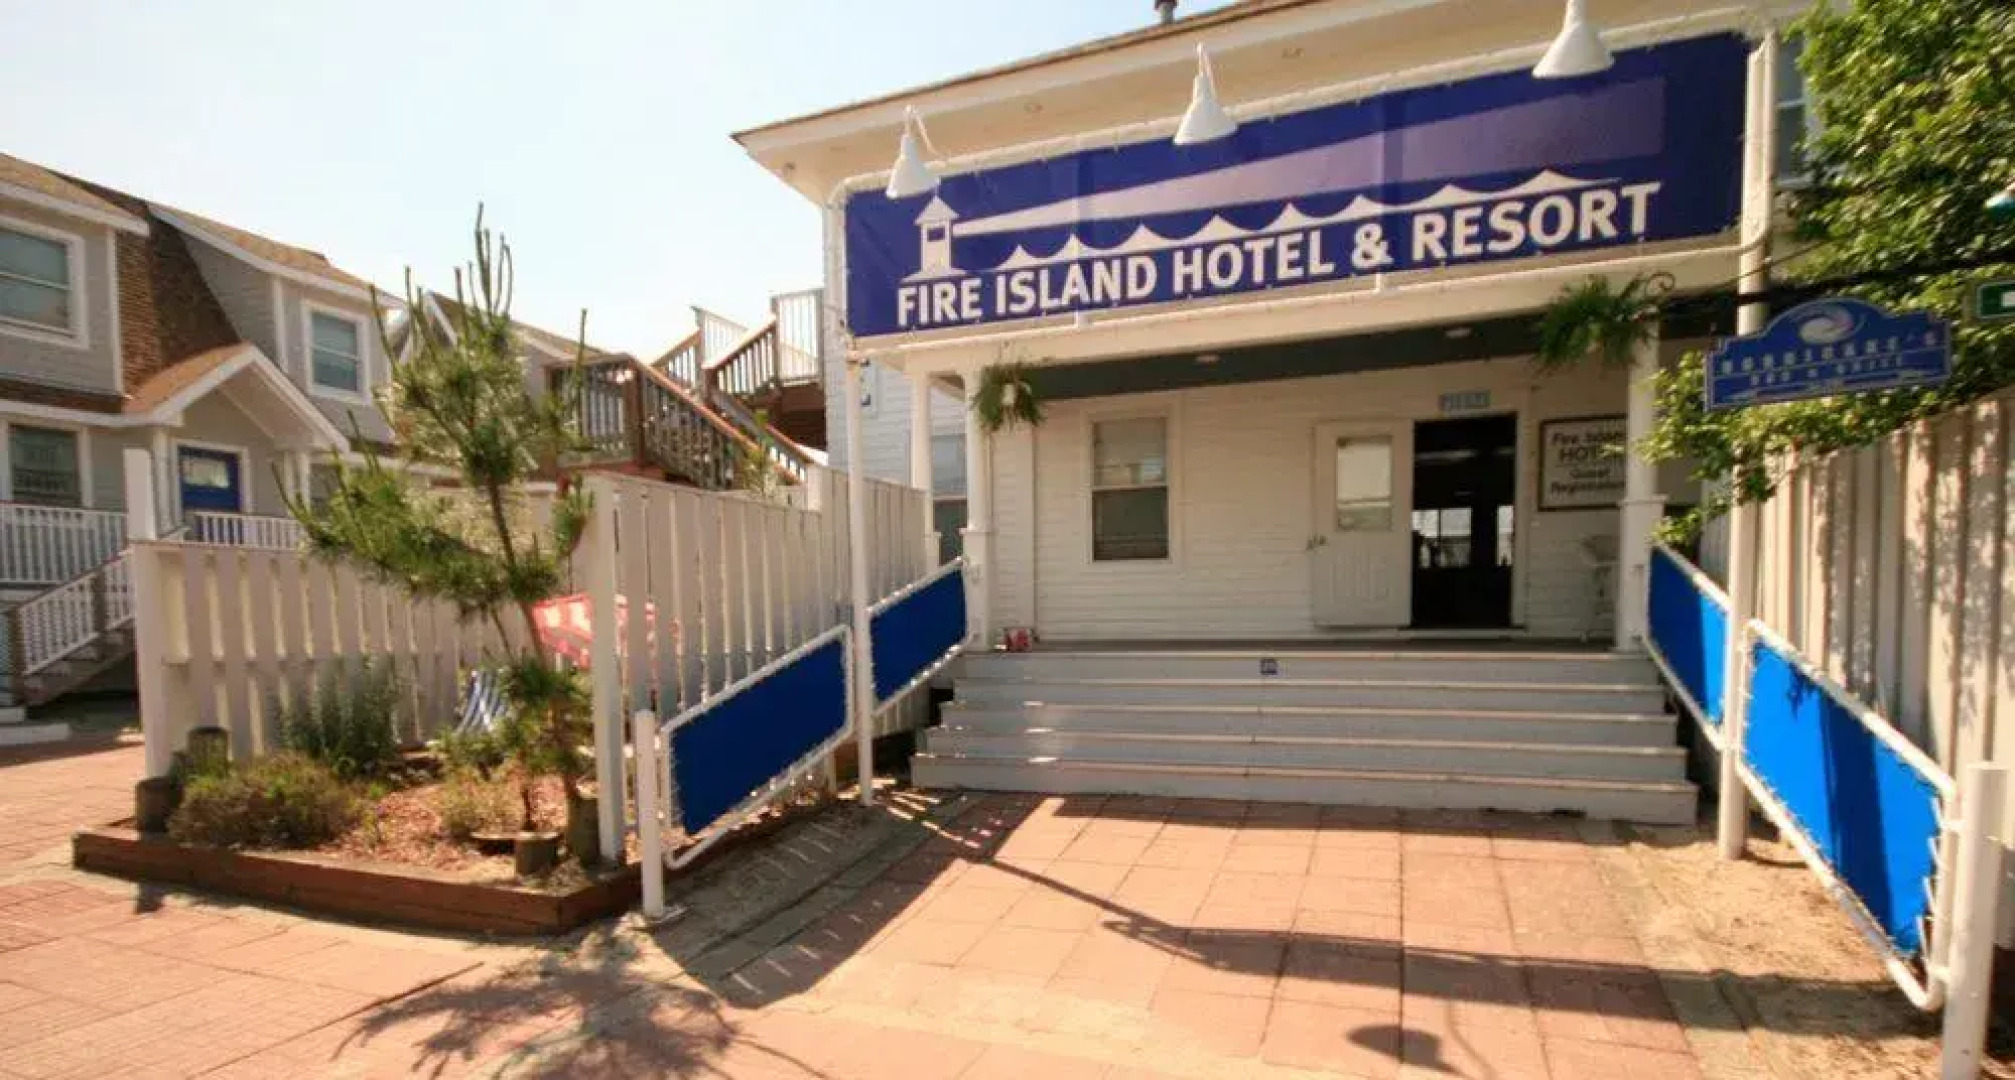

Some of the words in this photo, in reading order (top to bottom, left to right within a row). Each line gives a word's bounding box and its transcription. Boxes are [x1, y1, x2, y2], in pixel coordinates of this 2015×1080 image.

[897, 278, 982, 327] FIRE
[995, 255, 1157, 316] ISLAND
[1172, 229, 1334, 294] HOTEL
[1351, 222, 1394, 269] &
[1411, 181, 1662, 262] RESORT
